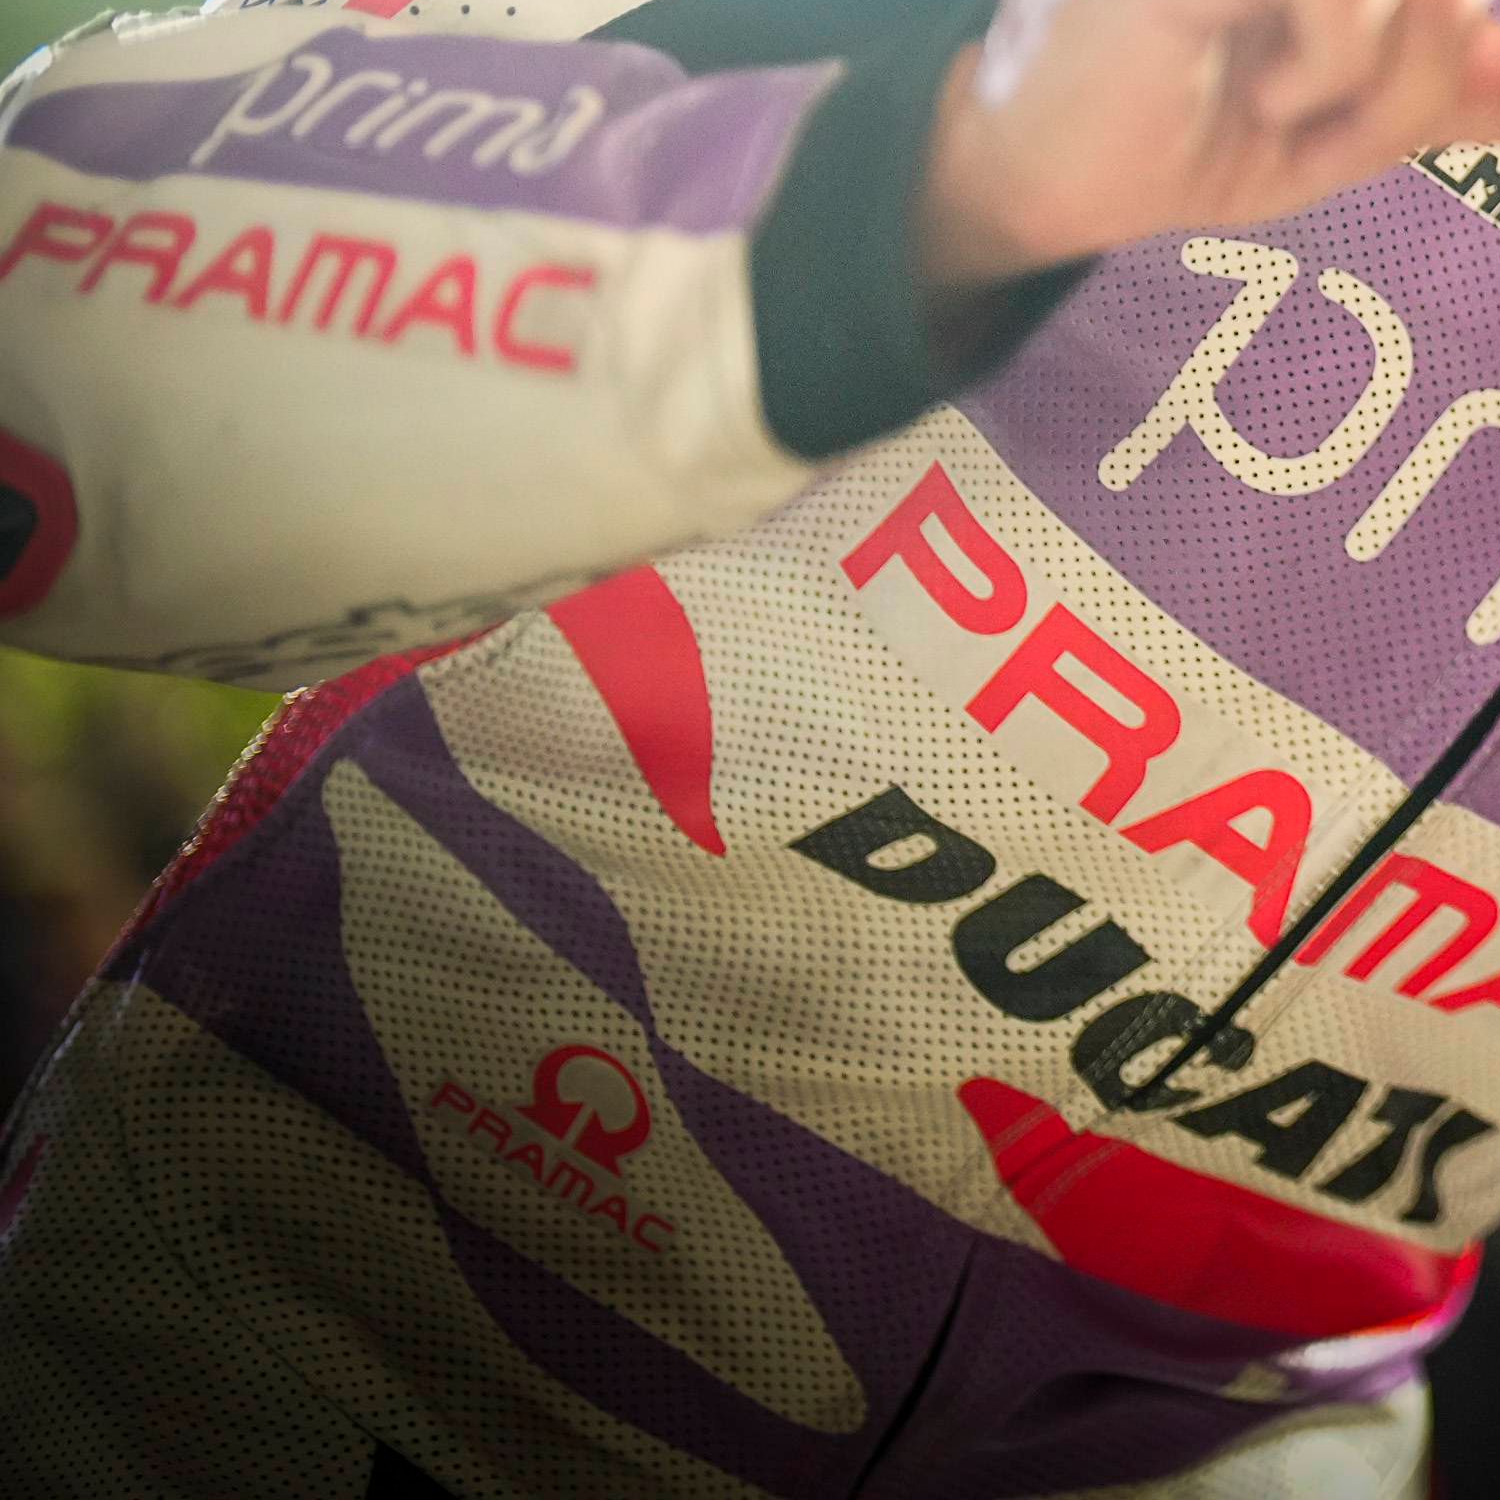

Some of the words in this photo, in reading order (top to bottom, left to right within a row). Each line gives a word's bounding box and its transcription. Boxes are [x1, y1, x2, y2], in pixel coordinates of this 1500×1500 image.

[190, 53, 604, 175] prima
[0, 200, 602, 374] PRAMAC
[786, 784, 1497, 1225] DUCATI
[429, 1080, 675, 1254] PRAMAC
